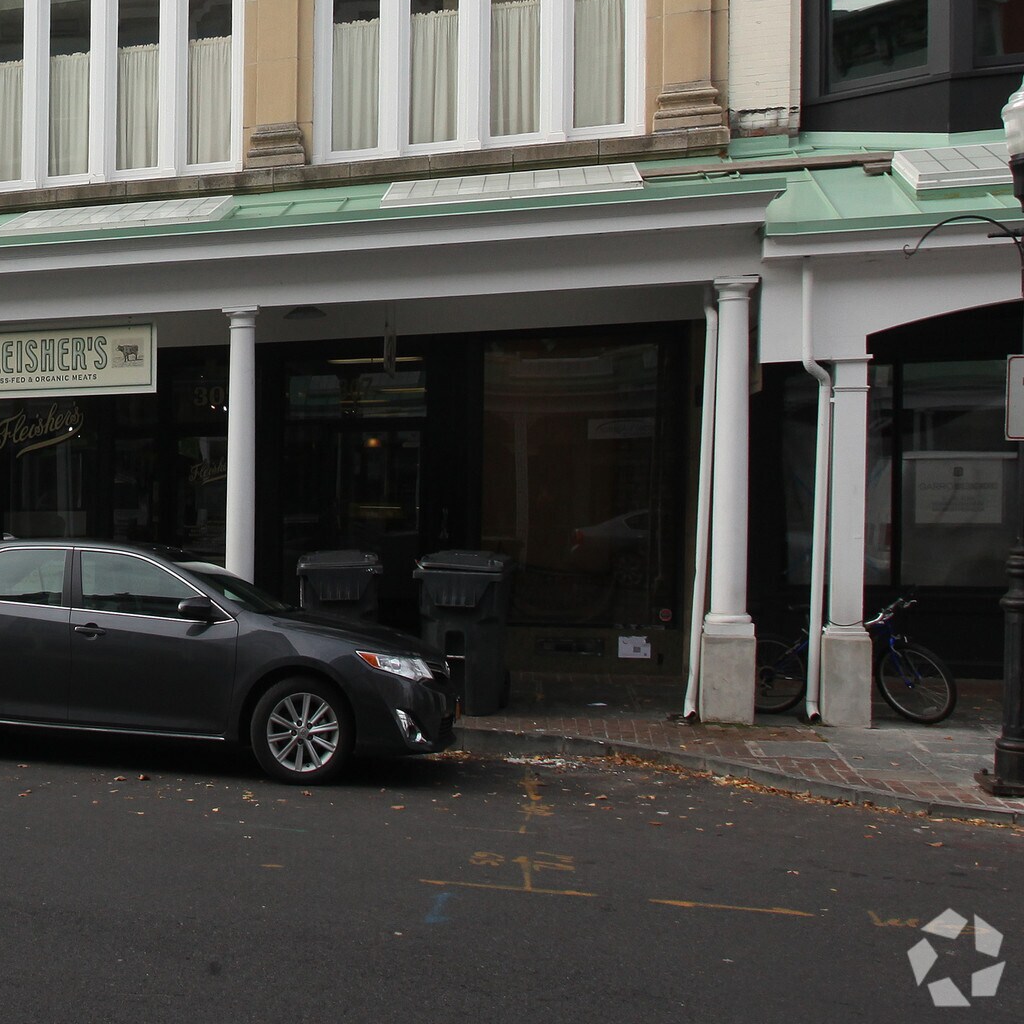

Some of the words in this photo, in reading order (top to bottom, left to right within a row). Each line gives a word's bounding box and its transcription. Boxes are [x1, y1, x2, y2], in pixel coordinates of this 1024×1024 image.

[35, 375, 70, 383] ORGANIC
[72, 373, 97, 381] MEATS
[192, 386, 226, 407] 30
